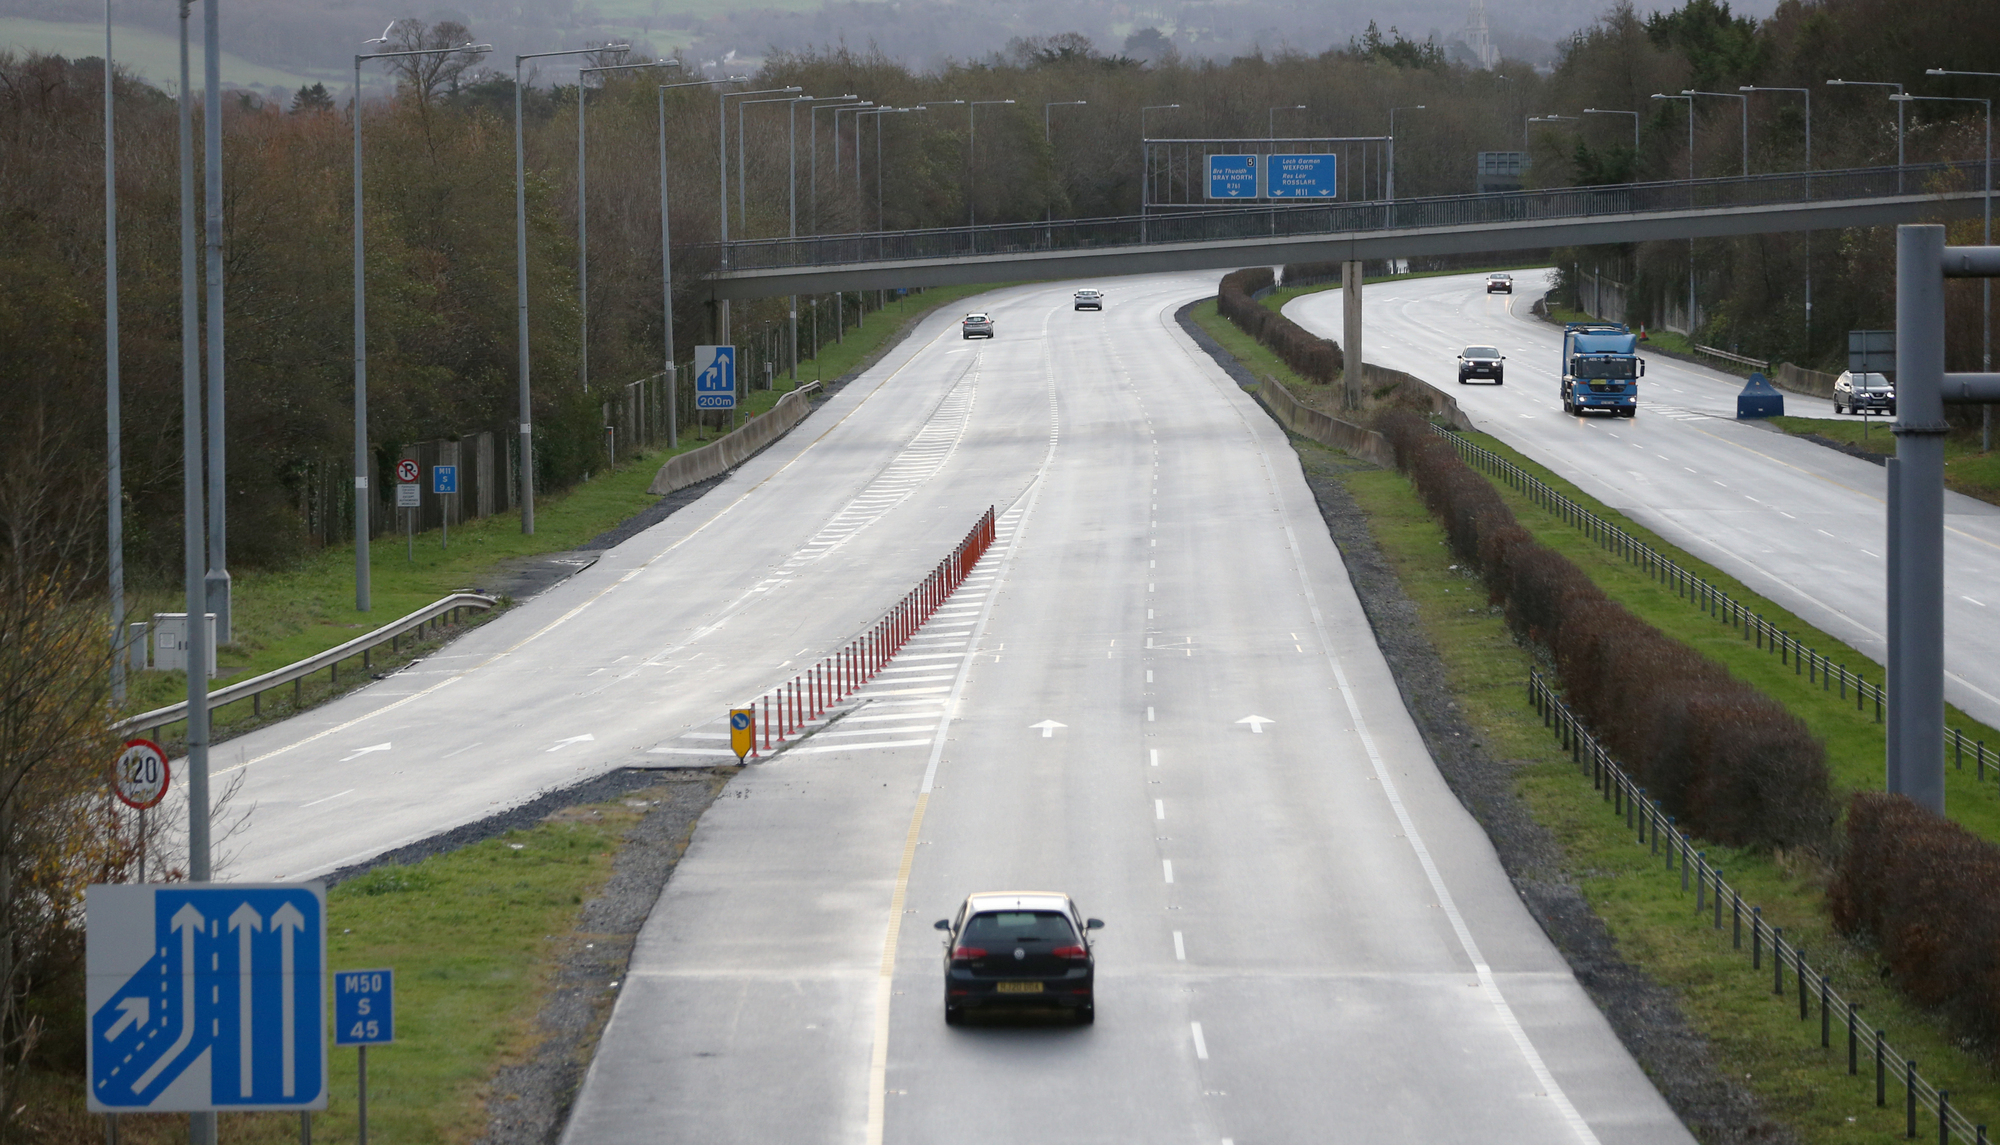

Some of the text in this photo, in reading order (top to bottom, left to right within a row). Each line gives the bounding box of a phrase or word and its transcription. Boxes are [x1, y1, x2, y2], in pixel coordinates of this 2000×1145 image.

[1248, 158, 1253, 167] 5
[700, 397, 732, 406] 200m
[124, 756, 157, 784] 120
[345, 974, 382, 994] M50
[358, 998, 371, 1015] S
[350, 1020, 379, 1038] 45
